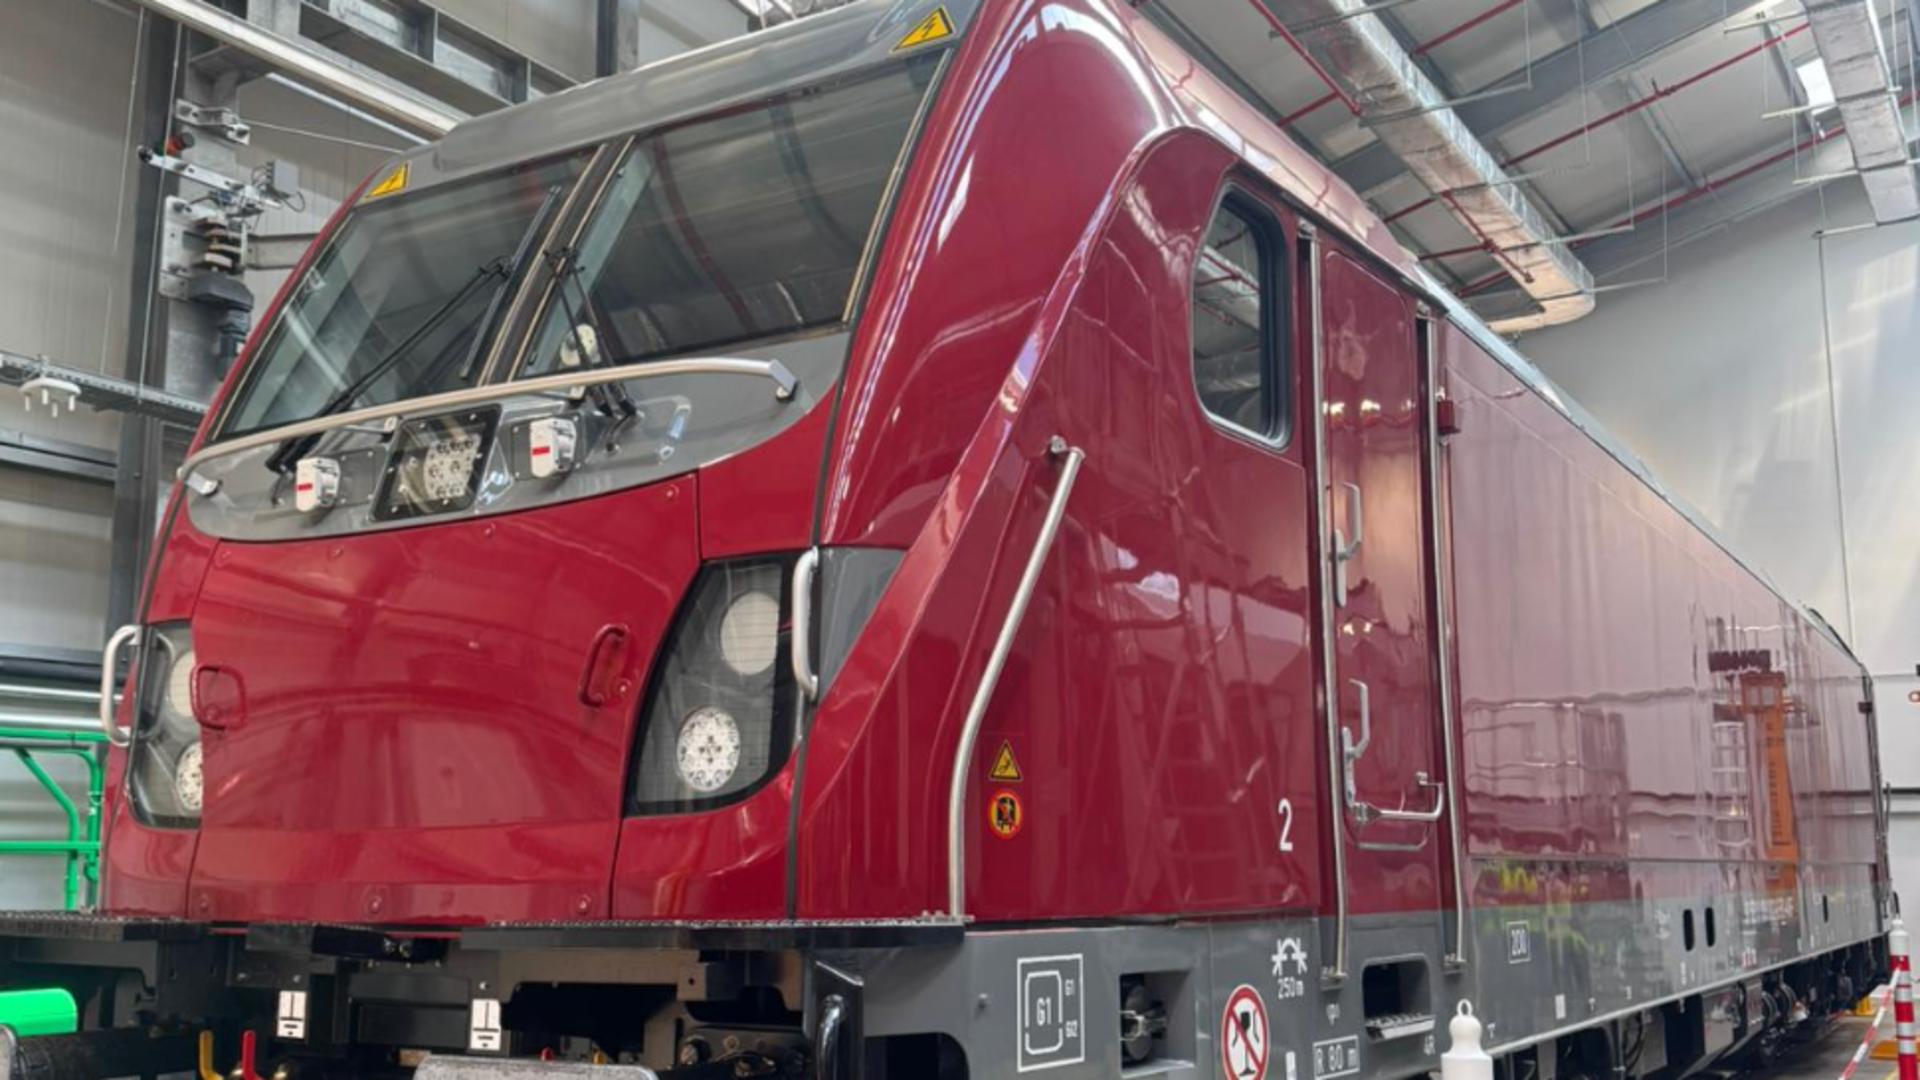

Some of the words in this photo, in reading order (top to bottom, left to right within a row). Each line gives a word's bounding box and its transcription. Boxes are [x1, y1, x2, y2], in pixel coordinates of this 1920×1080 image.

[1278, 798, 1293, 851] 2
[1037, 997, 1052, 1026] G1
[1315, 1047, 1325, 1074] R
[1328, 1044, 1344, 1071] 80
